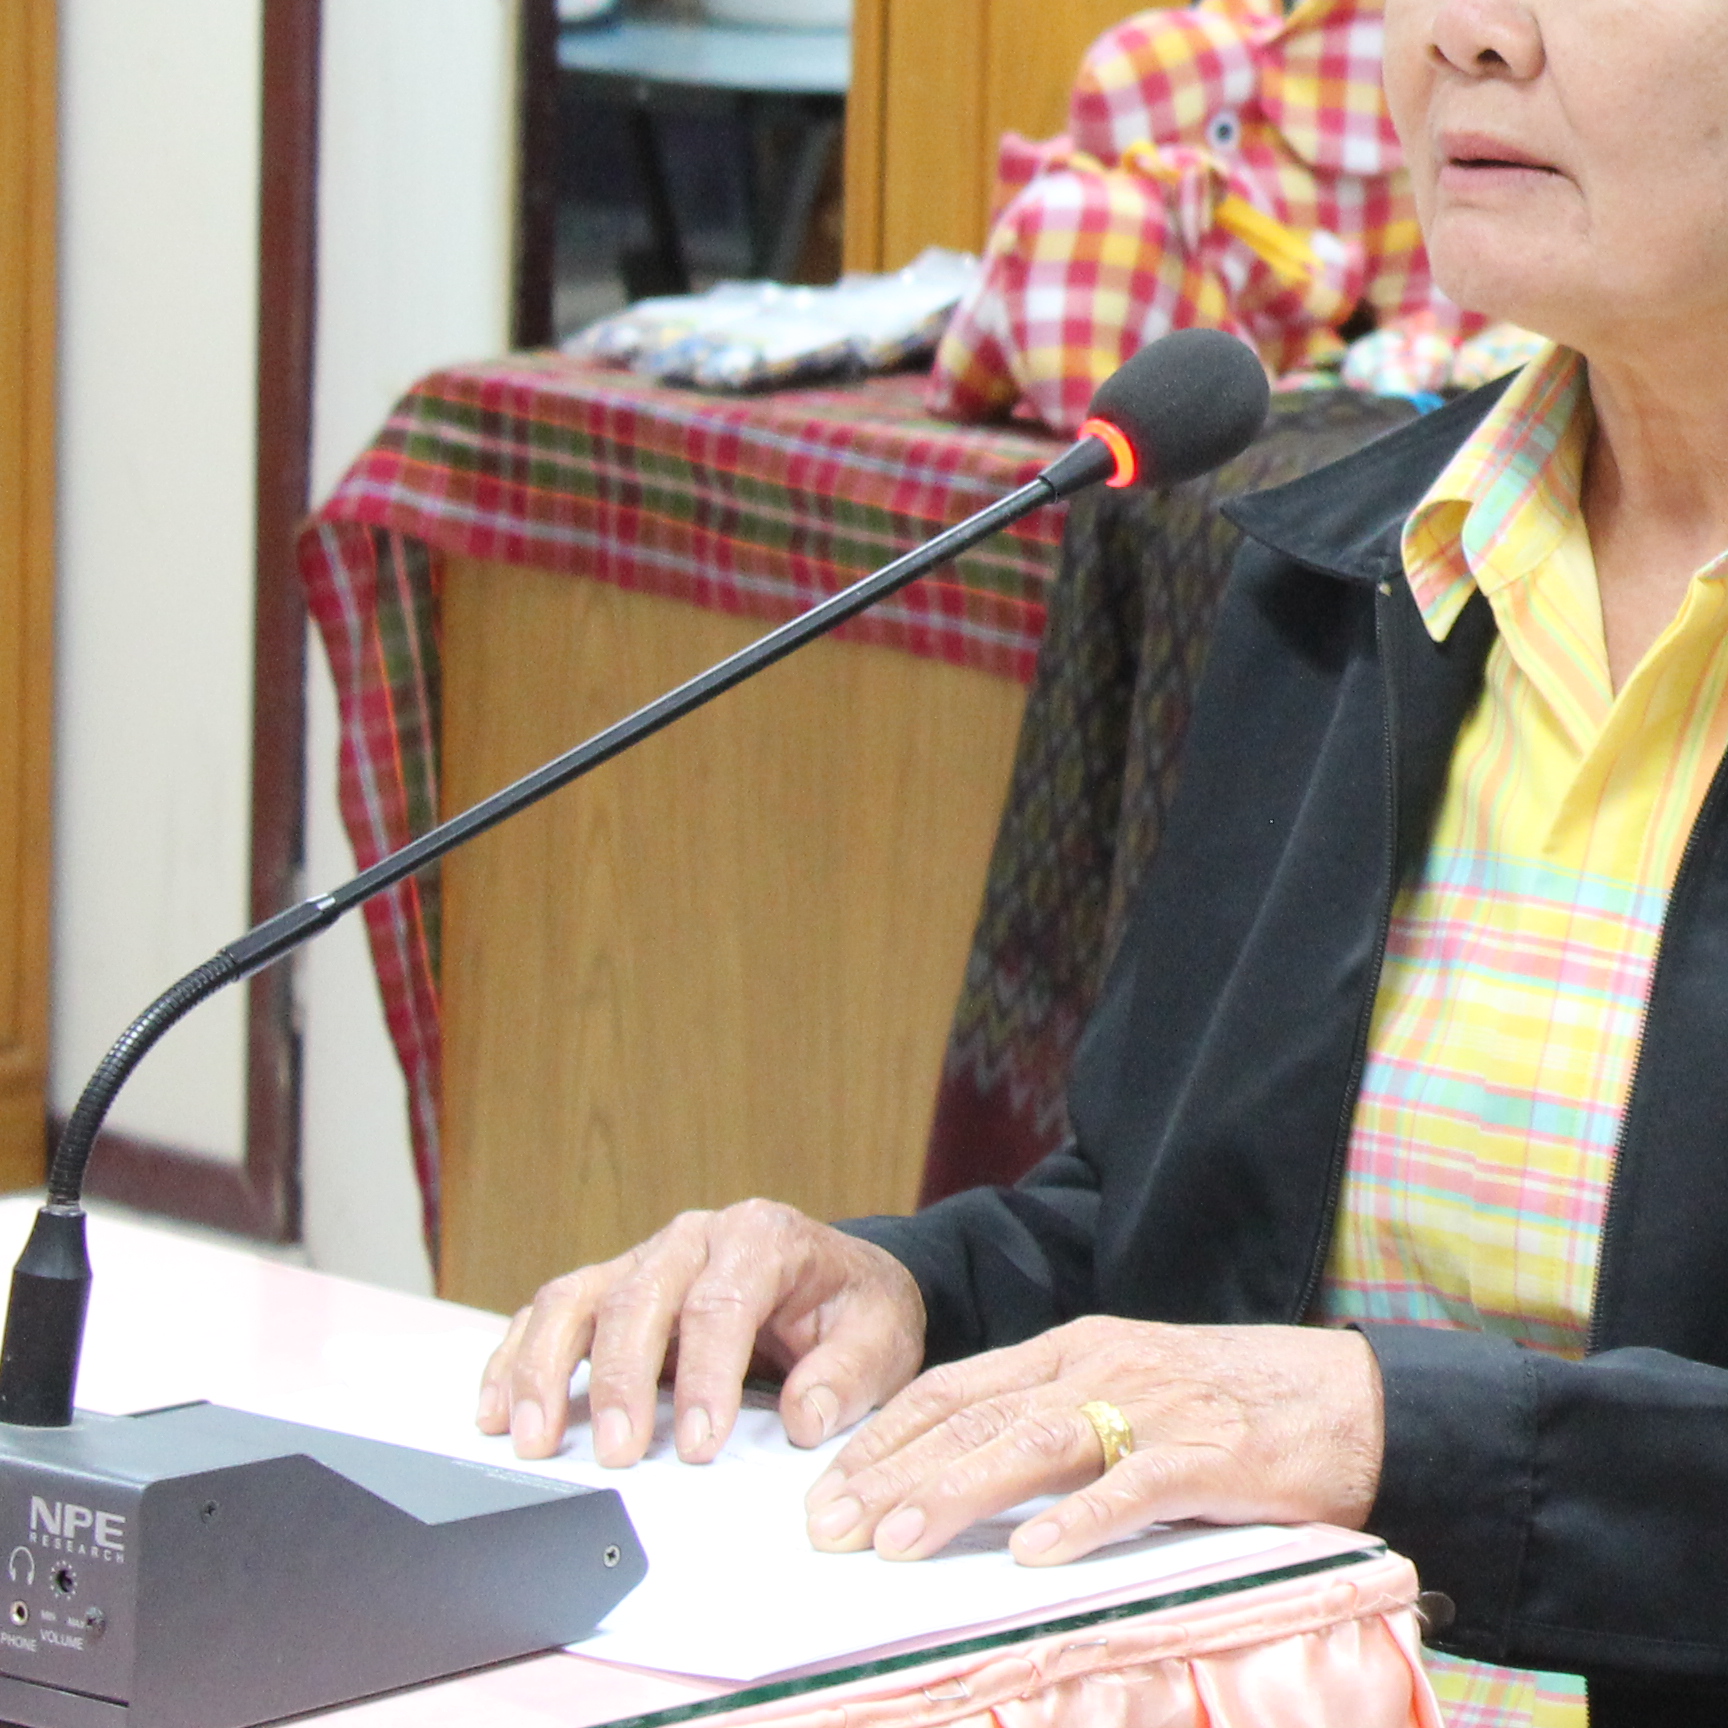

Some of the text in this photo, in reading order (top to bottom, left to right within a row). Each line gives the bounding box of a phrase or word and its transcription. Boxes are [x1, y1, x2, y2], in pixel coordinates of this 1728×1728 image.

[30, 1496, 126, 1551] NPE
[28, 1532, 123, 1563] RESEARCH
[0, 1632, 37, 1652] PHONE
[40, 1629, 84, 1651] VOLUME
